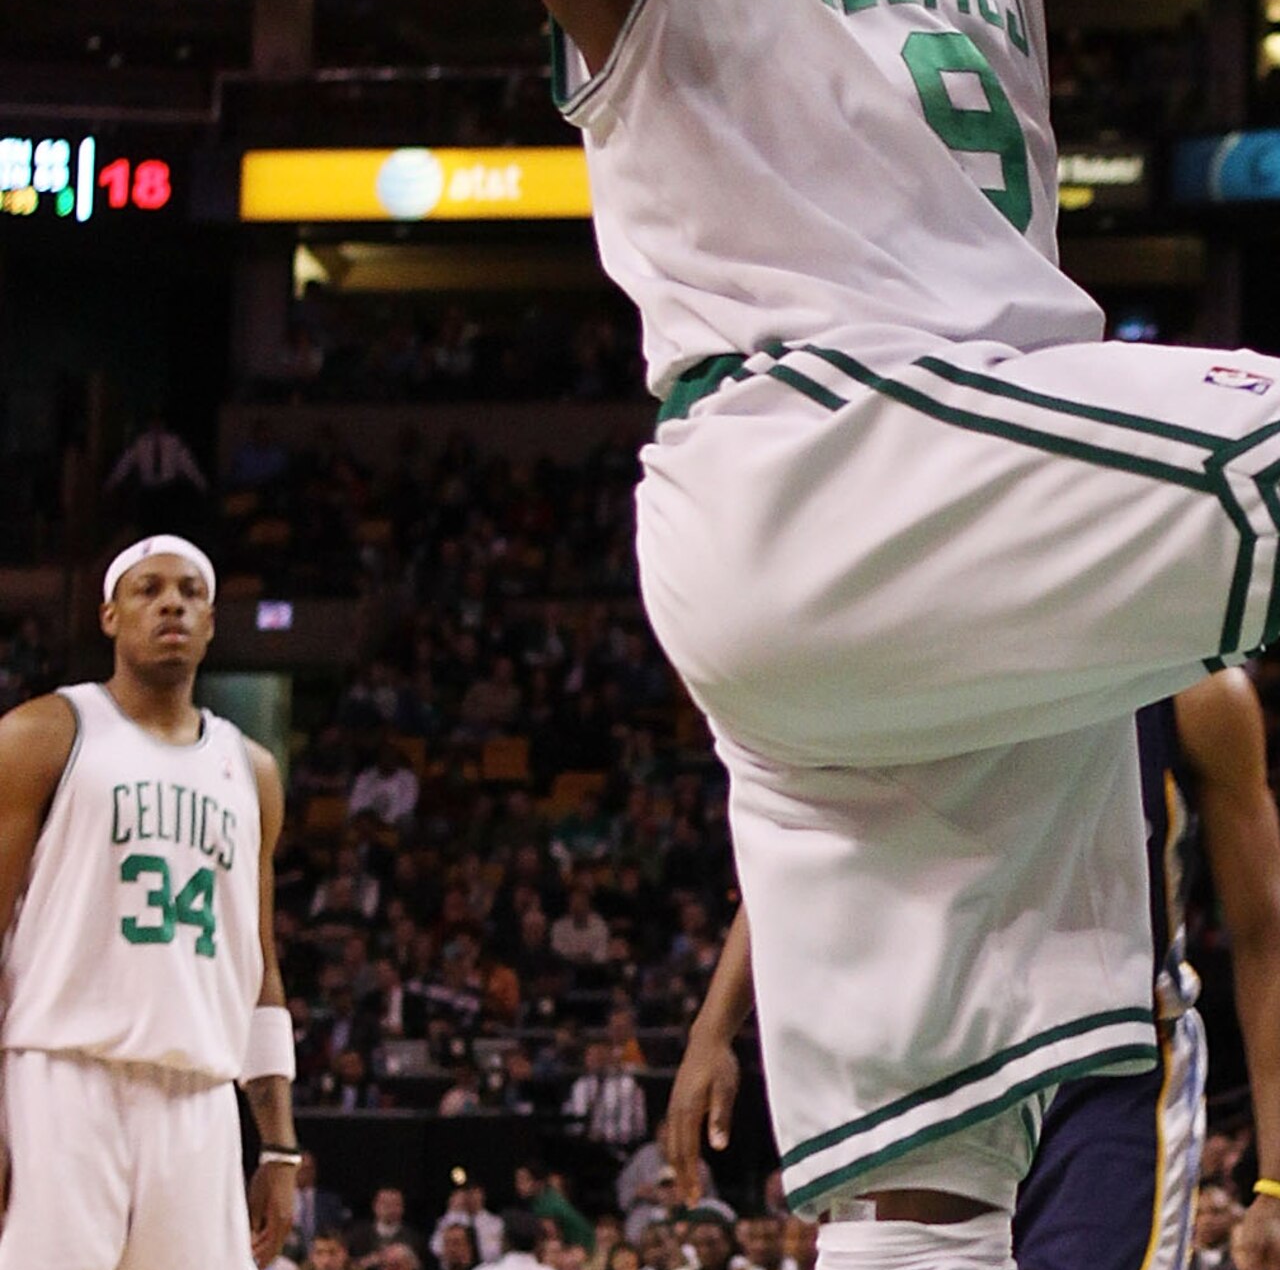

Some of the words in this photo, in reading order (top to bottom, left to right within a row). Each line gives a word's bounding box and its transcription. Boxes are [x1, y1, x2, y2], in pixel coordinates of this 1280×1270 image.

[900, 31, 1034, 235] 9
[98, 157, 172, 210] 18
[112, 780, 237, 871] CELTICS
[121, 853, 216, 959] 34
